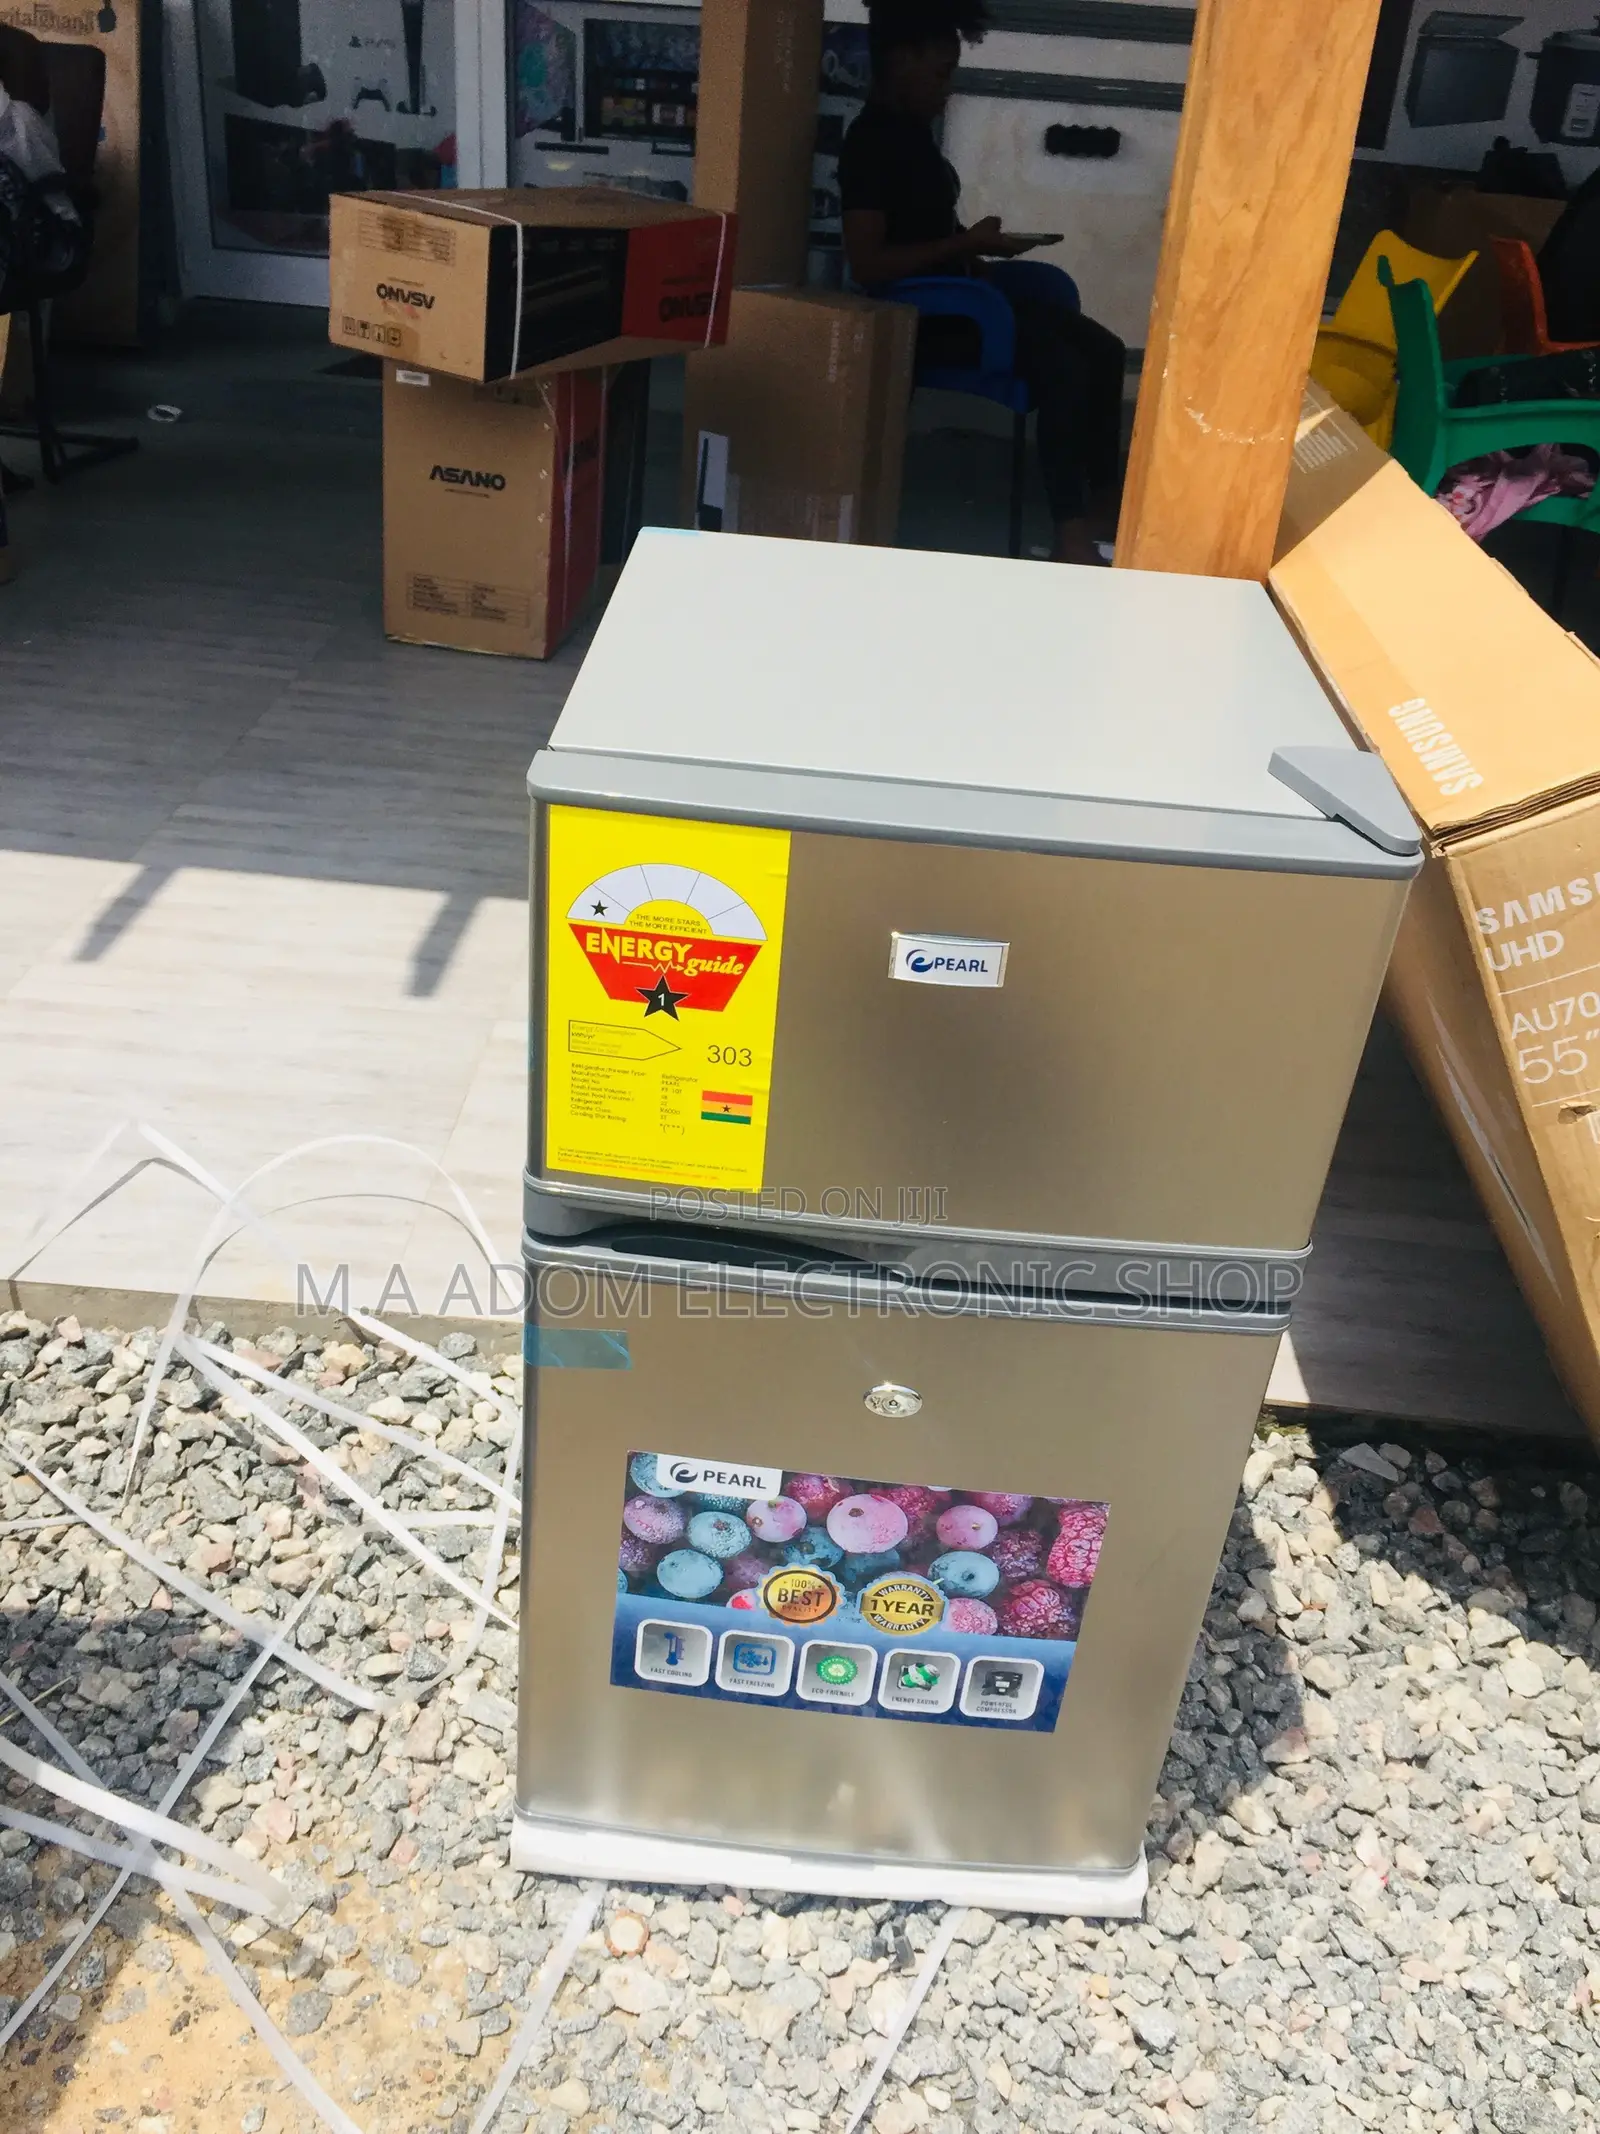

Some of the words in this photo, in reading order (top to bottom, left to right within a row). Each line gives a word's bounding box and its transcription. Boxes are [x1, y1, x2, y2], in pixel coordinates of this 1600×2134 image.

[429, 464, 507, 491] ASANO
[1388, 697, 1484, 796] SAMSUNG
[630, 920, 644, 928] THE
[645, 922, 669, 930] MORE
[669, 924, 708, 934] EFFICIENT
[652, 915, 675, 924] MORE
[676, 918, 701, 927] STARS
[586, 928, 693, 964] ENERGY
[683, 956, 745, 977] guide
[1484, 929, 1565, 972] UHD
[933, 956, 988, 973] PEARL
[658, 992, 665, 1006] 1
[706, 1044, 753, 1067] 303
[703, 1469, 767, 1490] PEARL
[777, 1589, 825, 1608] BEST
[878, 1583, 932, 1602] WARRANTY
[870, 1599, 878, 1611] 1
[881, 1599, 935, 1617] YEAR
[873, 1614, 926, 1632] WARRANTY
